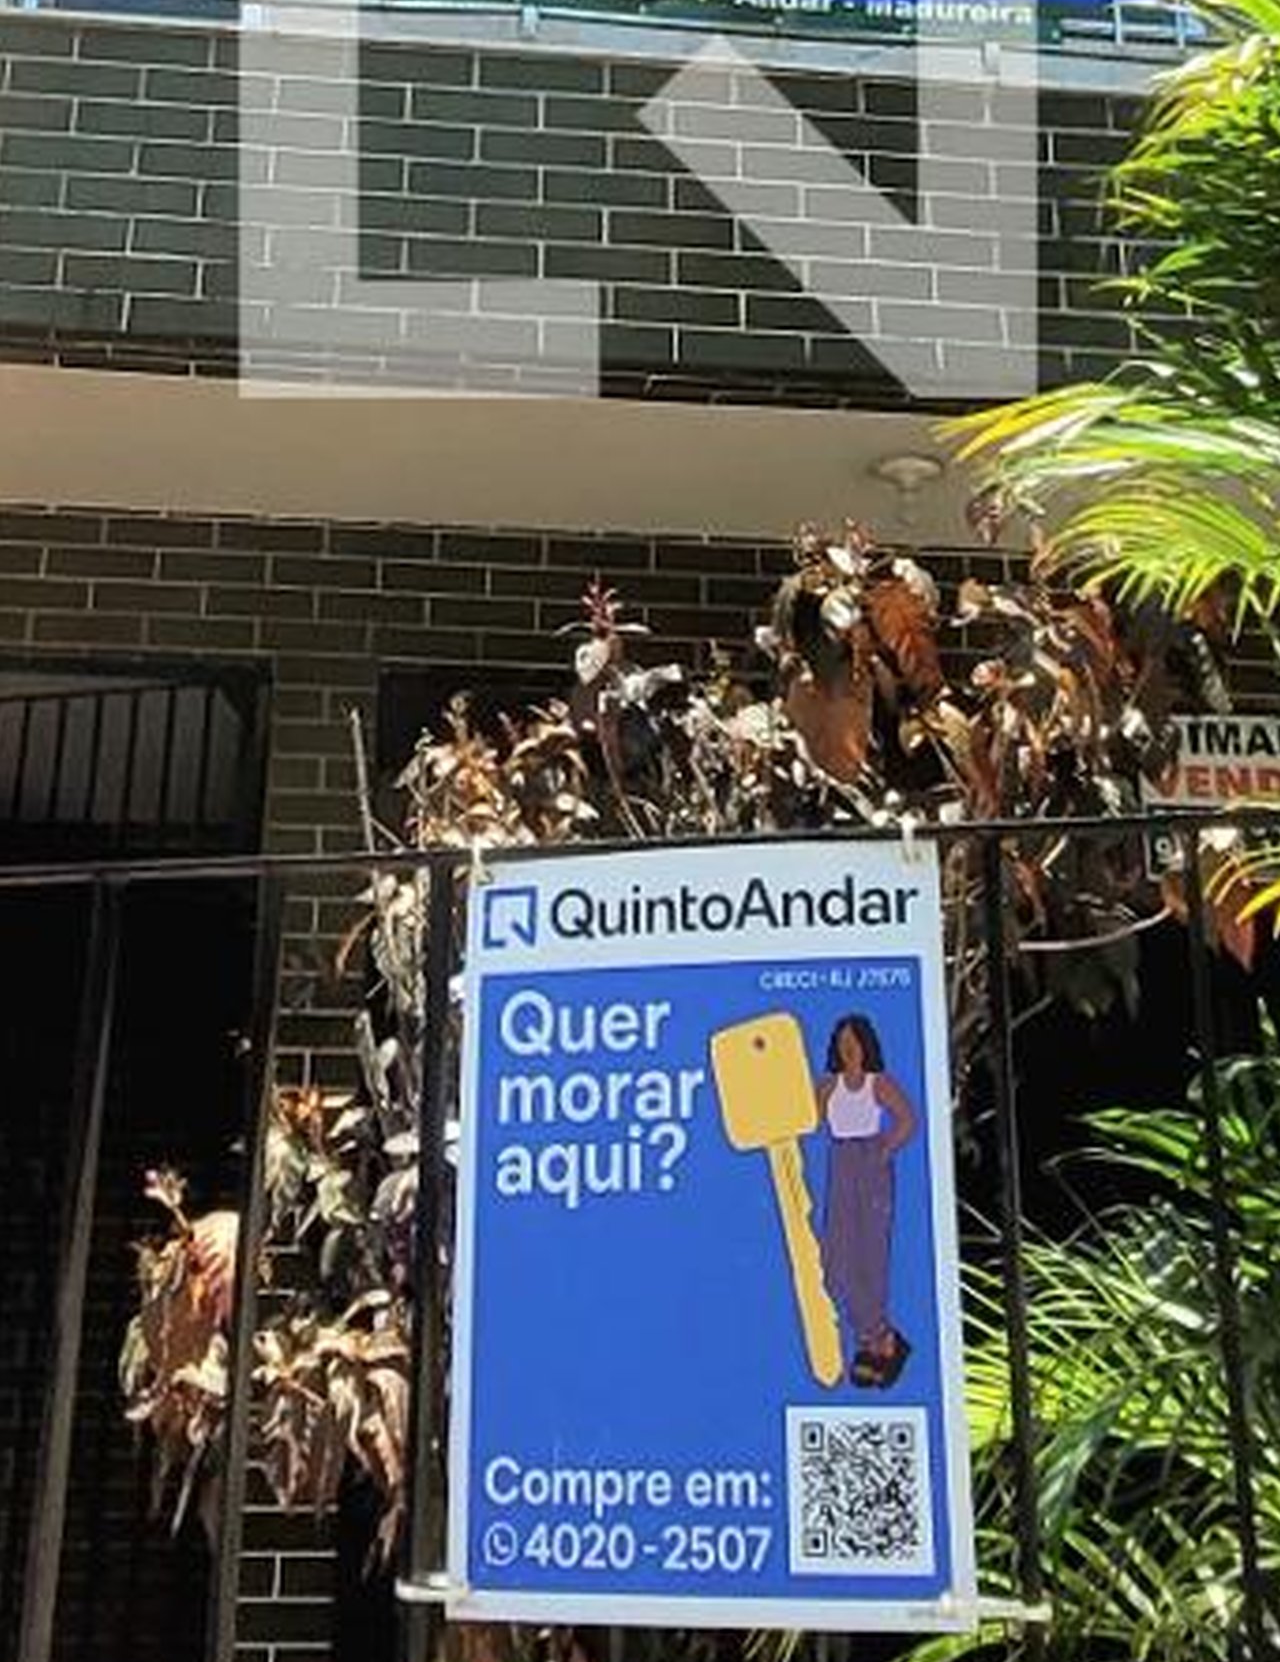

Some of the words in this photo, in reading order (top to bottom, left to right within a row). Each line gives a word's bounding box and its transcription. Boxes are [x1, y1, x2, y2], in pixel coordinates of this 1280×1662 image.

[551, 876, 919, 939] QuintoAndar
[500, 989, 671, 1056] Quer
[498, 1069, 705, 1124] morar
[495, 1122, 687, 1210] aqui?
[485, 1456, 673, 1519] Compre
[685, 1469, 772, 1508] em:
